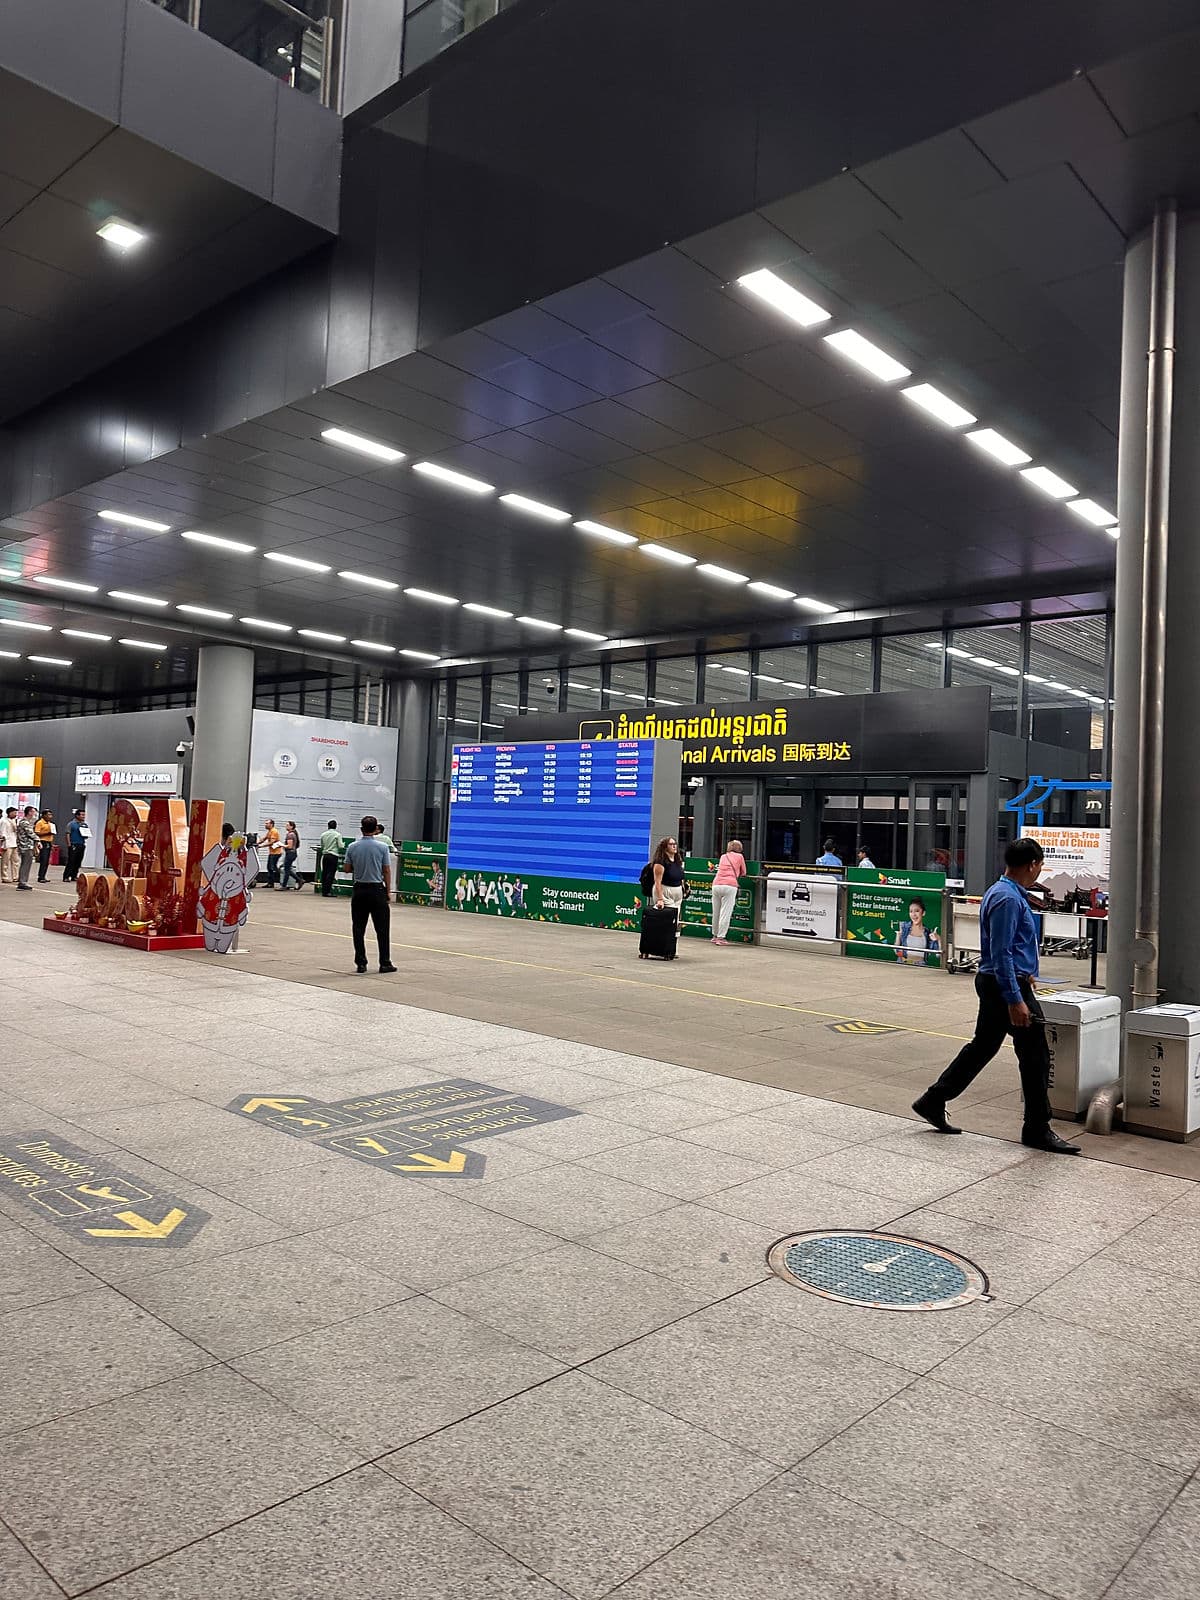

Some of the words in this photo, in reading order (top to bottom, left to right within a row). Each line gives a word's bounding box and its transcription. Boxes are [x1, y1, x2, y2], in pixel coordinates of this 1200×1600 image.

[311, 737, 349, 746] SHAREHOLDERS
[711, 745, 776, 763] Arrivals
[783, 742, 851, 762] 国际到达
[147, 774, 155, 783] OF
[1025, 830, 1060, 838] 240-Hour
[1062, 831, 1100, 839] Visa-Free
[1060, 839, 1069, 847] of
[1071, 839, 1099, 848] China
[887, 876, 911, 886] Smart
[455, 877, 528, 906] SMART
[542, 887, 558, 898] Stay
[560, 888, 599, 901] connected
[542, 900, 558, 909] with
[559, 902, 585, 912] Smart!
[873, 895, 904, 904] coverage,
[615, 905, 638, 915] Smart
[852, 901, 871, 909] better
[873, 902, 901, 912] internet.
[852, 909, 863, 917] Use
[864, 910, 885, 919] Smart!
[1149, 1065, 1161, 1109] Waste
[343, 1085, 462, 1110] Departures
[364, 1088, 496, 1119] International
[409, 1104, 530, 1133] Departures
[431, 1114, 539, 1140] Domestic
[15, 1140, 95, 1179] Domestic
